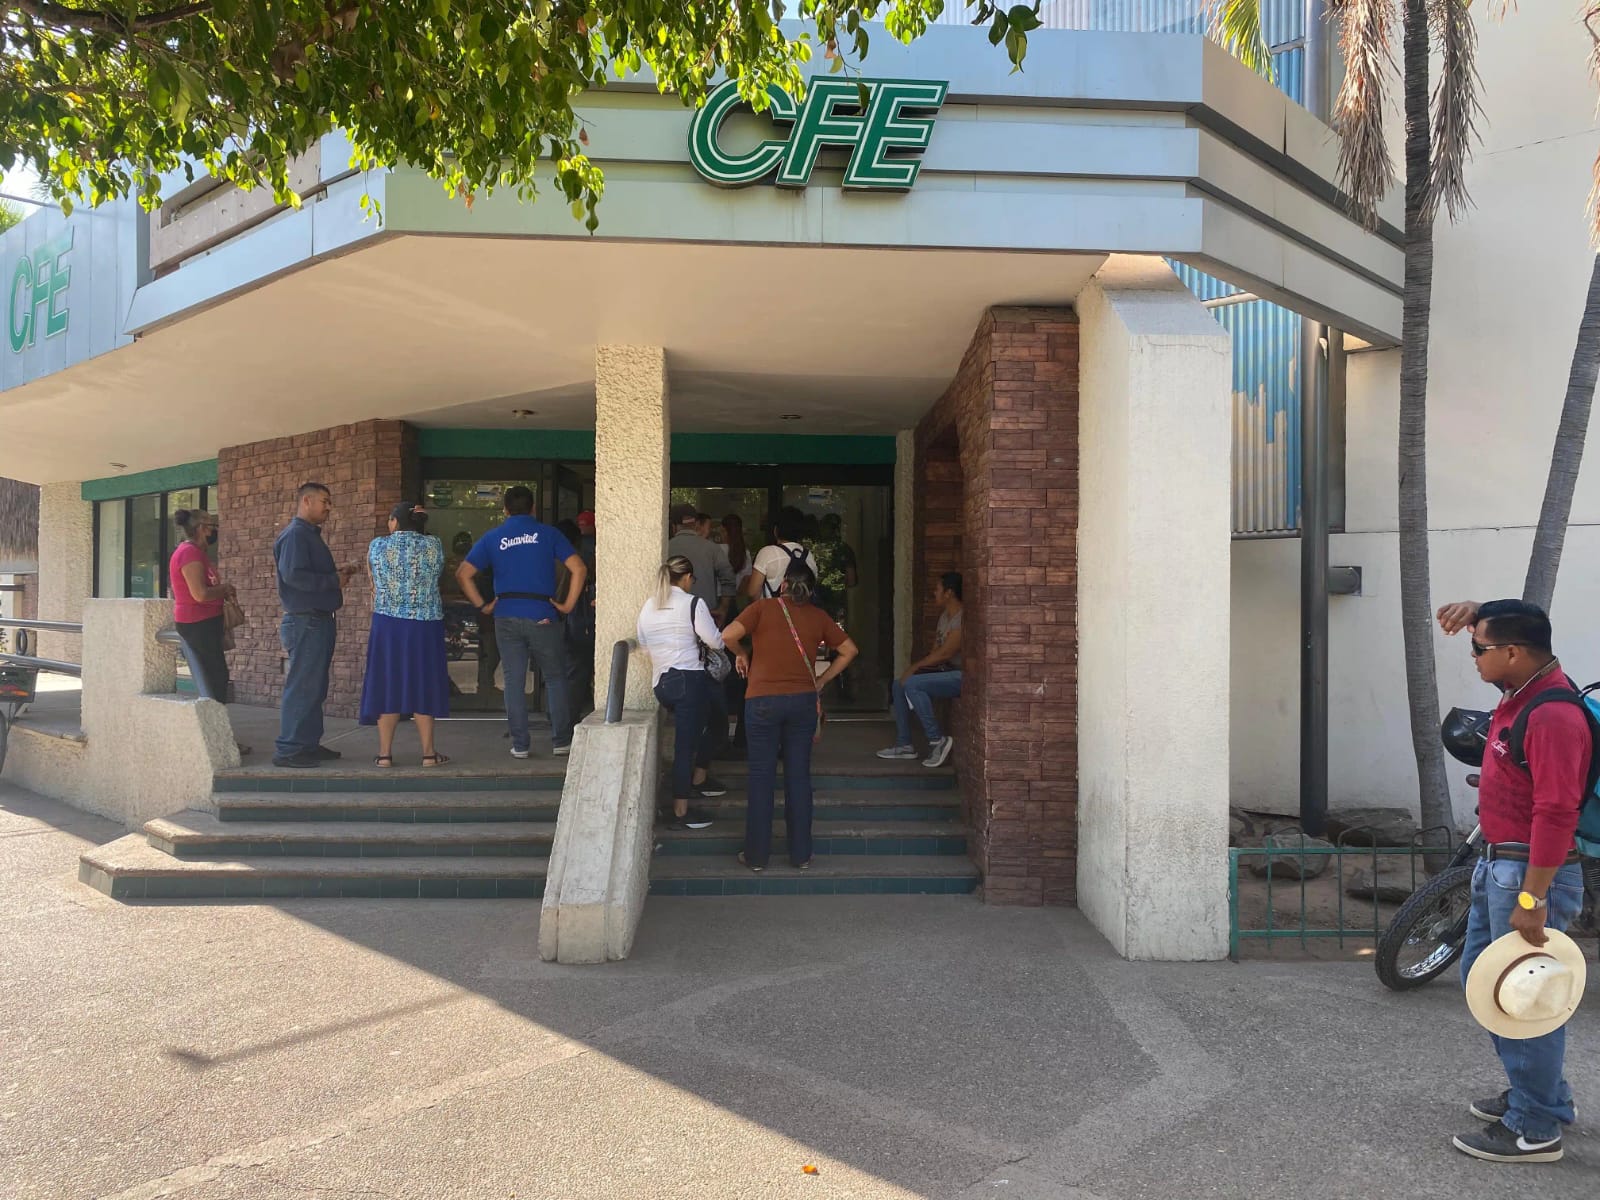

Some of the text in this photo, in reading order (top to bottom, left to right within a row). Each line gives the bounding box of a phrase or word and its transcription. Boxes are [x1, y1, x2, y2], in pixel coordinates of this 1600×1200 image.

[688, 76, 949, 189] CFE
[9, 224, 74, 353] CFE
[500, 533, 538, 550] Suavitel
